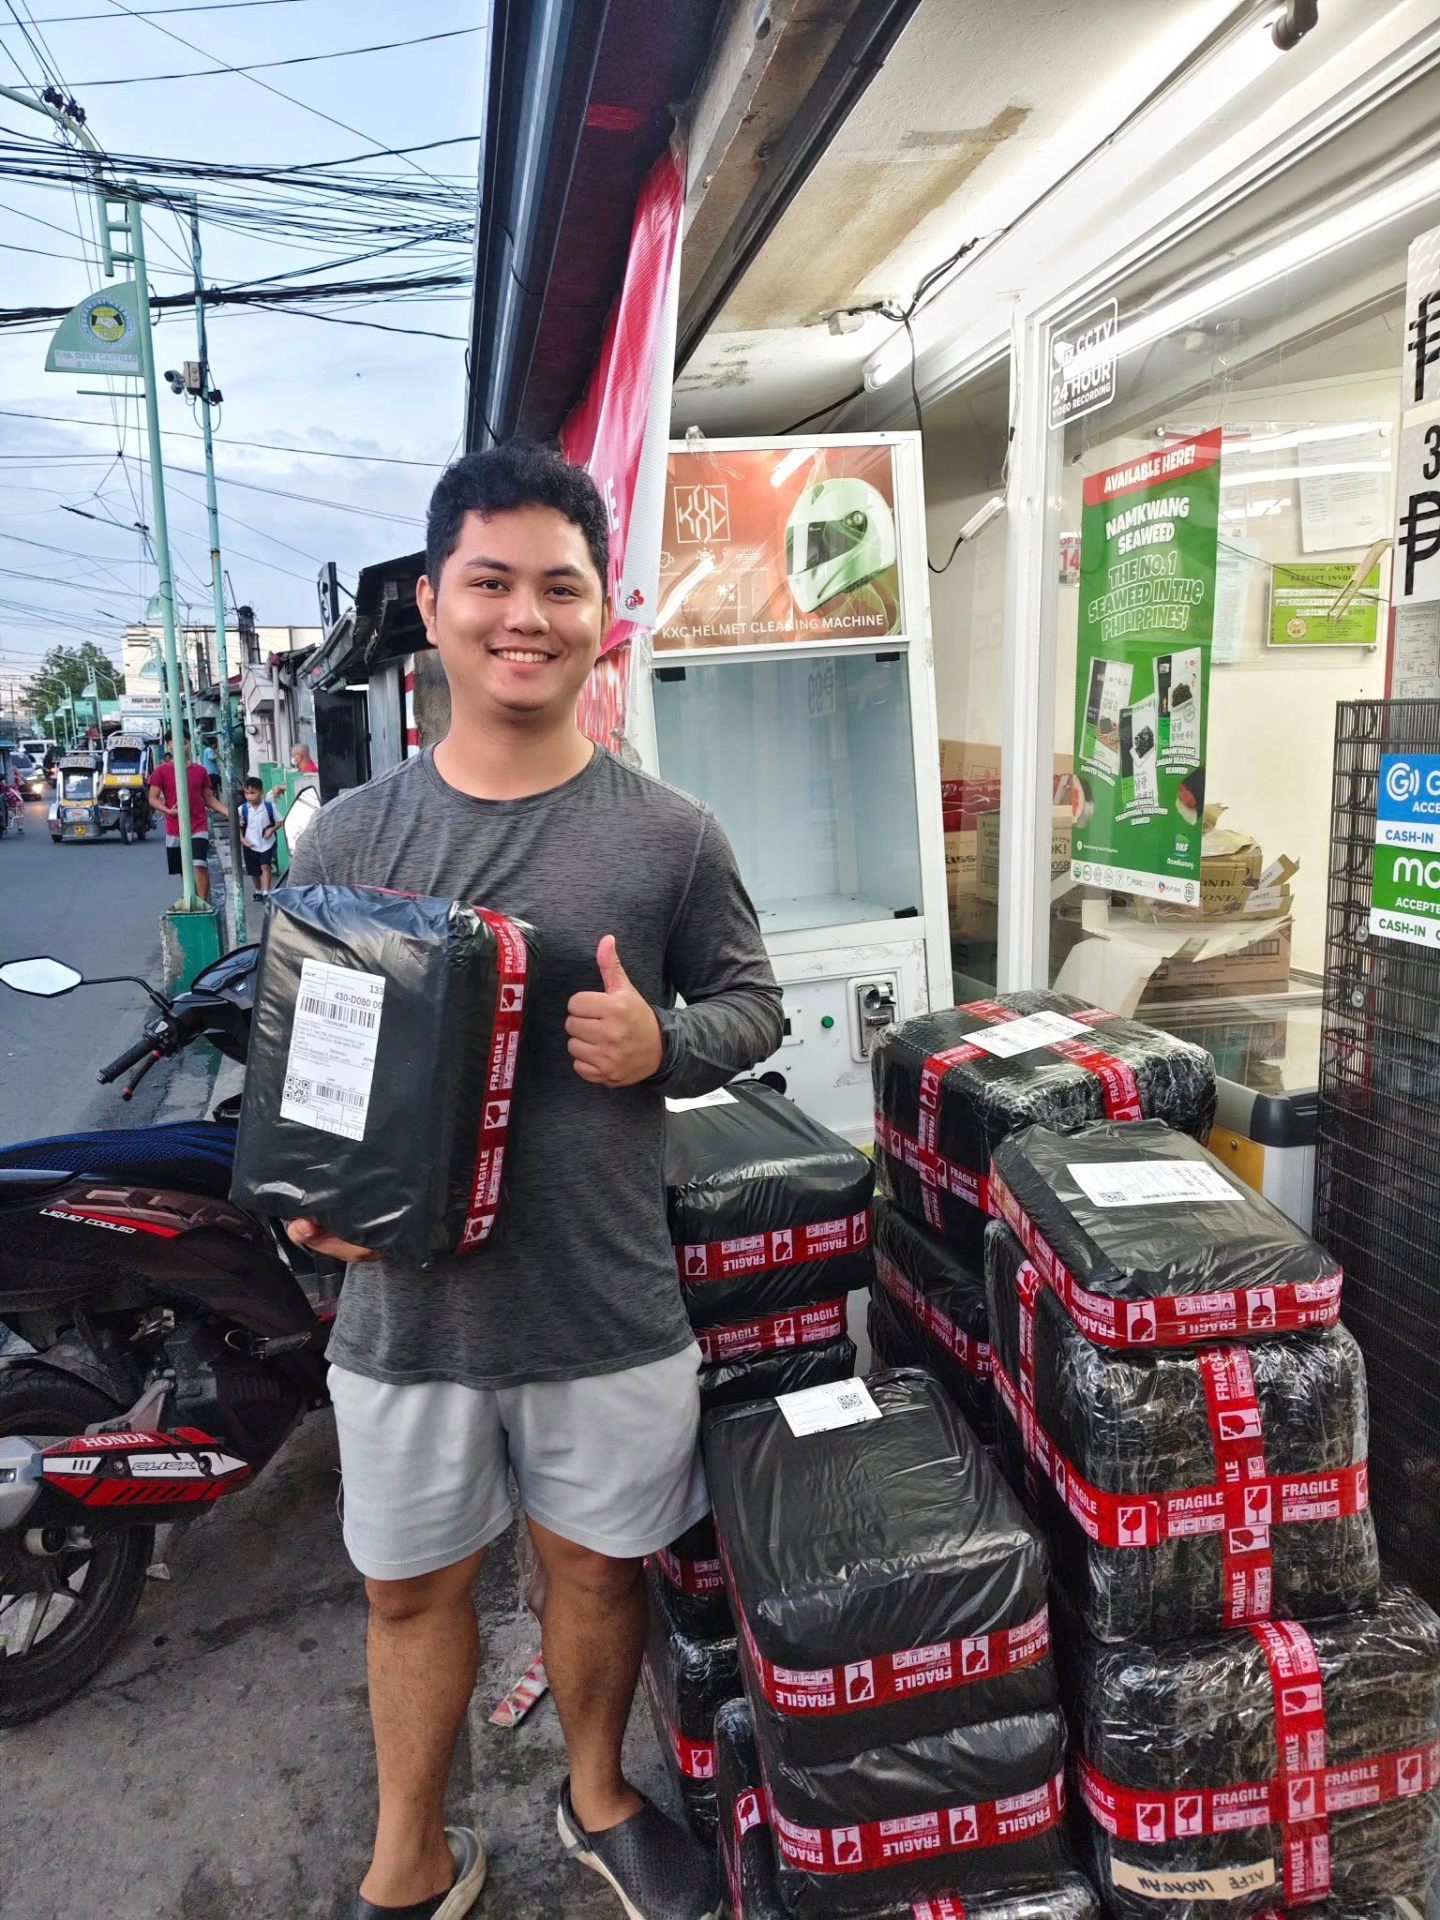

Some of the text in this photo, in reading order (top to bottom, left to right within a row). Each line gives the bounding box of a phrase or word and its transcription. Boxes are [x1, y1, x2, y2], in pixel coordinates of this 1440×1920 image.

[1075, 318, 1113, 354] CCTV
[1052, 359, 1112, 407] 24 HOUR
[1052, 382, 1111, 419] VIDEO RECORDING
[1104, 444, 1196, 493] AVAILABLE HERE!
[1105, 496, 1190, 541] NAMKWANG
[1117, 522, 1176, 556] SEAWEED
[1108, 550, 1178, 590] THE NO. 1
[1088, 581, 1152, 624] SEAWEED
[1152, 579, 1173, 602] IN
[662, 627, 689, 639] KXC
[692, 622, 747, 638] HELMET
[822, 614, 884, 629] MACHINE
[1101, 605, 1190, 641] PHILIPPINES!
[1385, 829, 1435, 845] CASH-IN
[1378, 918, 1427, 938] CASH-IN
[489, 1033, 505, 1091] FRAGILE
[928, 1114, 936, 1155] FRAGILE
[474, 1149, 490, 1209] FRAGILE
[950, 1165, 979, 1189] FRAGILE
[39, 1207, 137, 1234] LIQUID COOLED
[807, 1236, 848, 1255] FRAGILE
[723, 1253, 767, 1272] FRAGILE
[801, 1305, 841, 1326] FRAGILE
[717, 1326, 760, 1345] FRAGILE
[81, 1433, 155, 1448] HONDA
[132, 1460, 197, 1472] CLICK
[1225, 1460, 1240, 1483] ILE
[1067, 1475, 1098, 1515] FRAGILE
[1167, 1491, 1224, 1512] FRAGILE
[1282, 1478, 1339, 1498] FRAGILE
[1232, 1570, 1247, 1620] FRAGILE
[1258, 1621, 1293, 1679] FRAGILE
[895, 1666, 952, 1693] FRAGILE
[776, 1689, 836, 1708] FRAGILE
[1325, 1764, 1379, 1787] FRAGILE
[1212, 1786, 1269, 1807] FRAGILE
[998, 1807, 1051, 1835] FRAGILE
[883, 1834, 941, 1858] FRAGILE
[1291, 1840, 1305, 1892] FRAGILE
